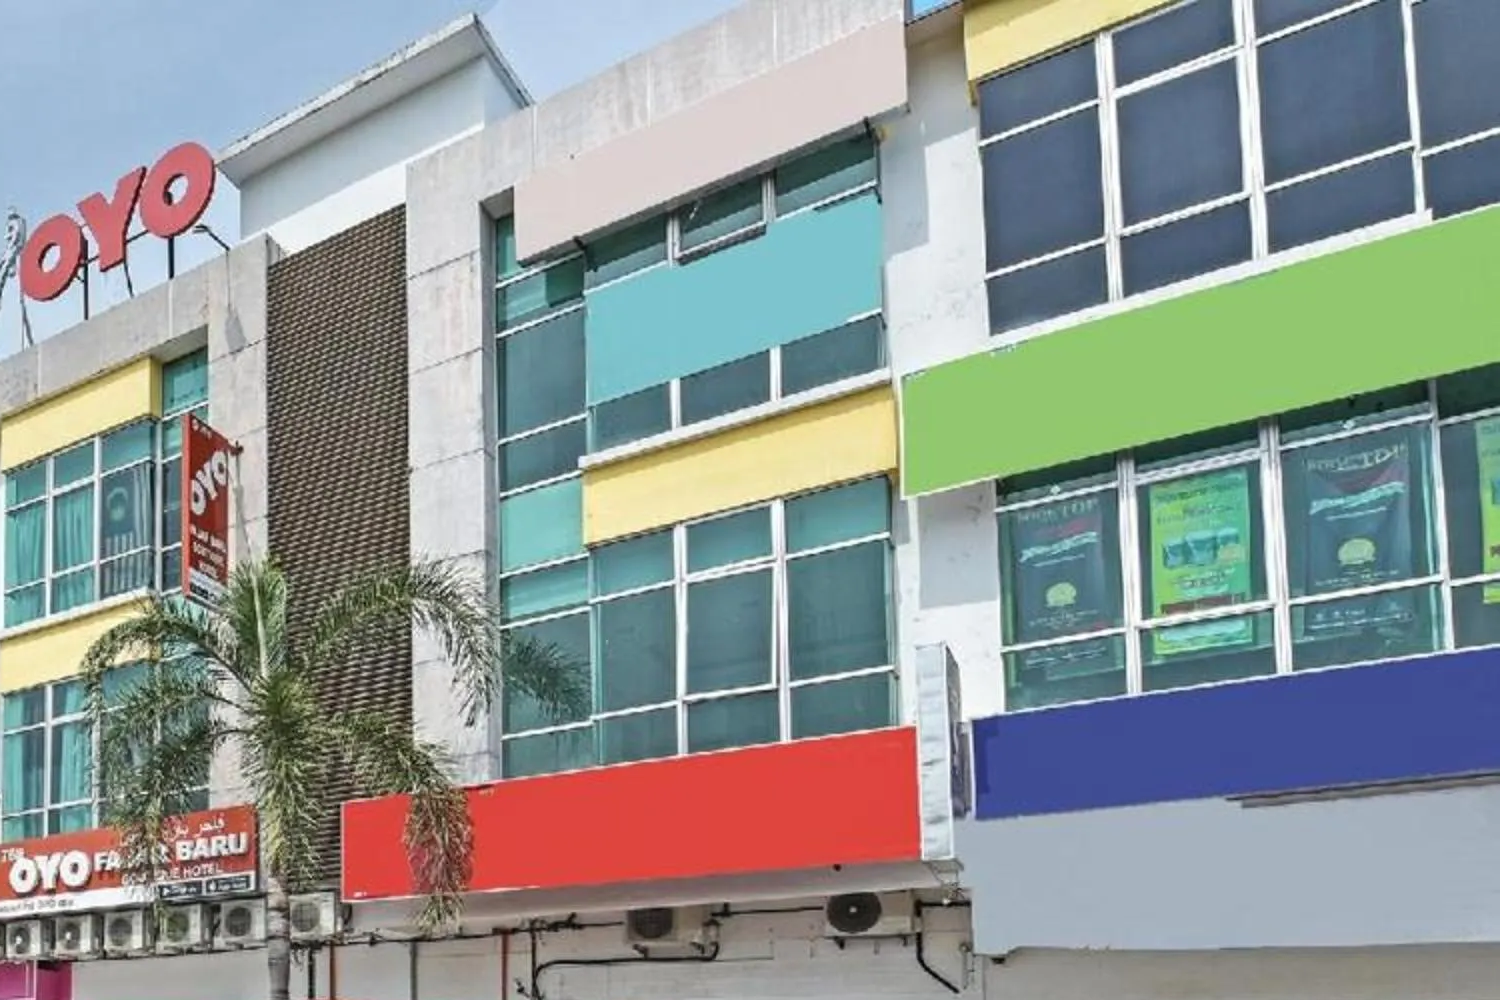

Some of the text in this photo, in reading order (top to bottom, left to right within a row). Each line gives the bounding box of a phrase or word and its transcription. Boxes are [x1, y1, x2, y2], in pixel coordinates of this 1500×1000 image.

[19, 141, 217, 302] OYO
[190, 450, 228, 516] OYO
[9, 850, 91, 894] OYO
[175, 831, 249, 862] BARU
[184, 862, 224, 878] HOTEL
